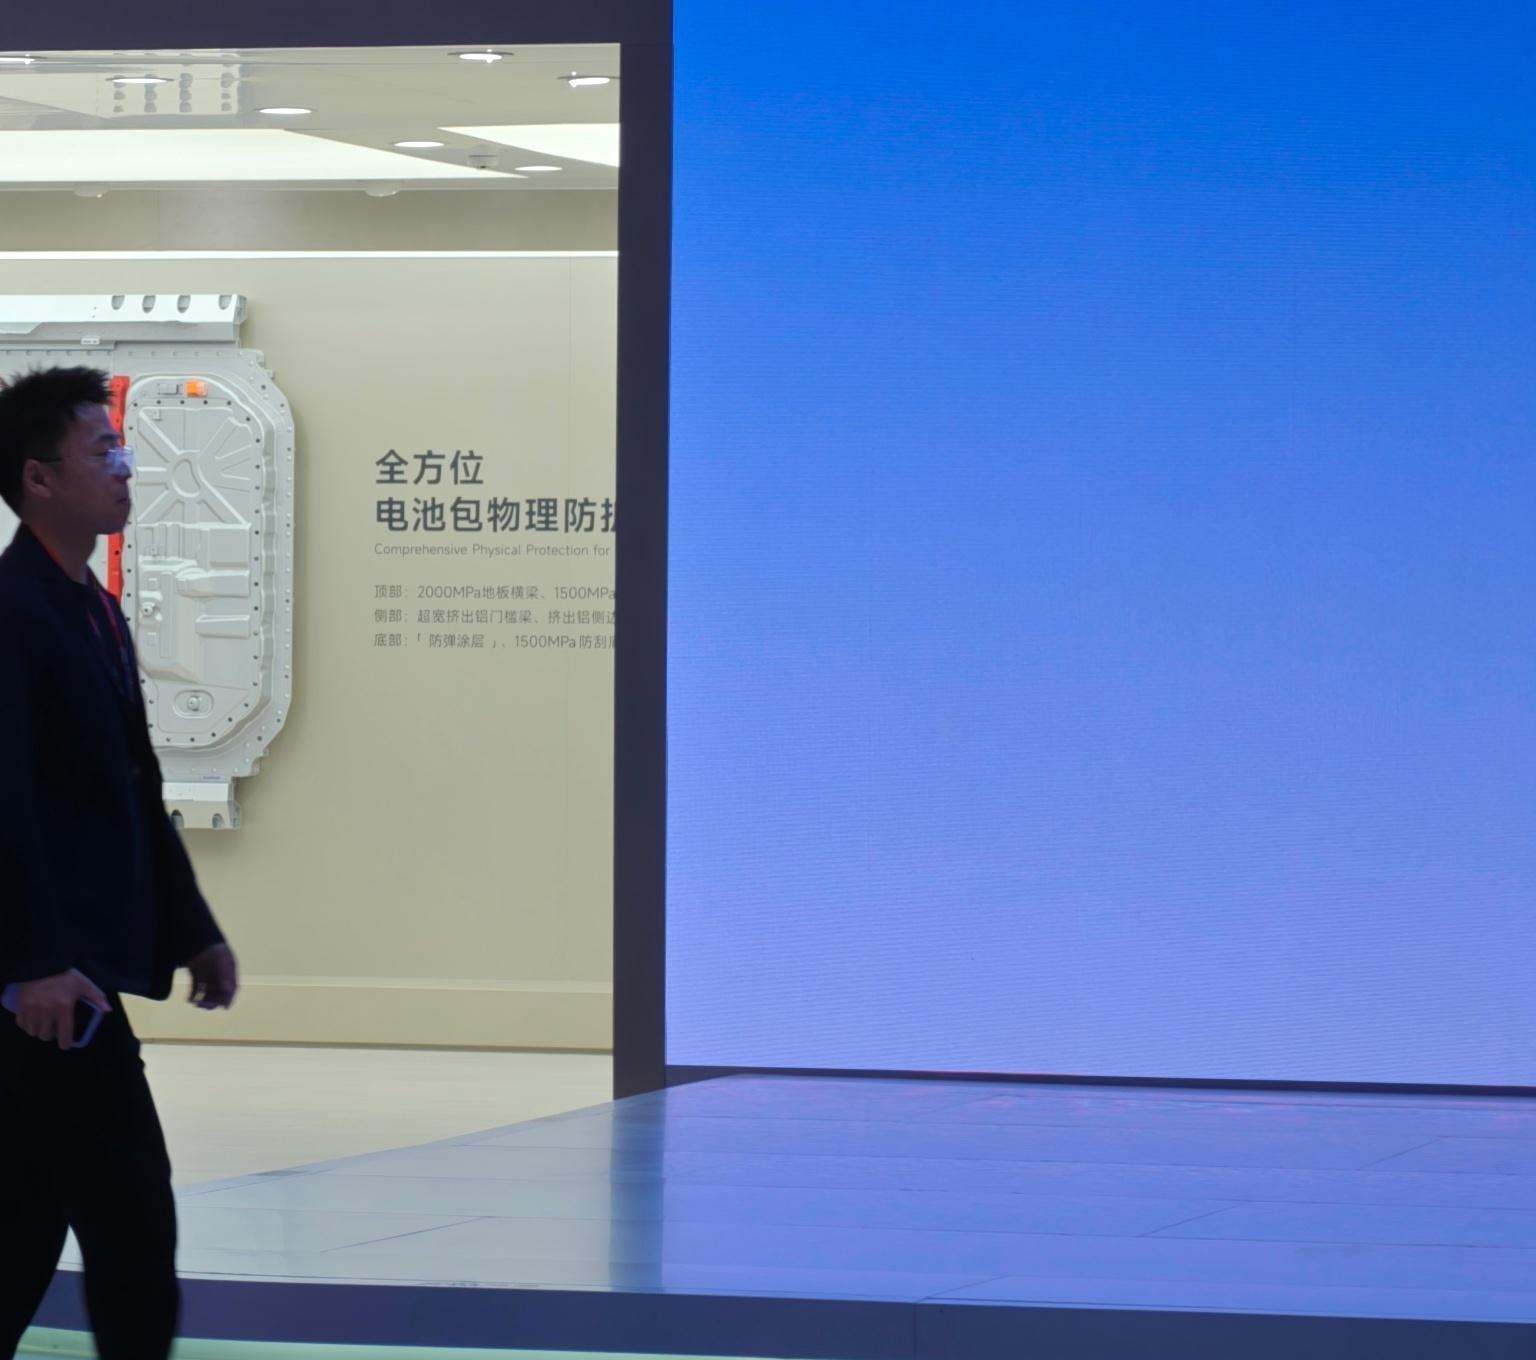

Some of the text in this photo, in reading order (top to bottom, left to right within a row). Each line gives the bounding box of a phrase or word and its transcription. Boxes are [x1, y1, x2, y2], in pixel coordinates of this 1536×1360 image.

[375, 448, 484, 486] 全方位
[374, 543, 610, 558] Comprehensive Physical Protection for
